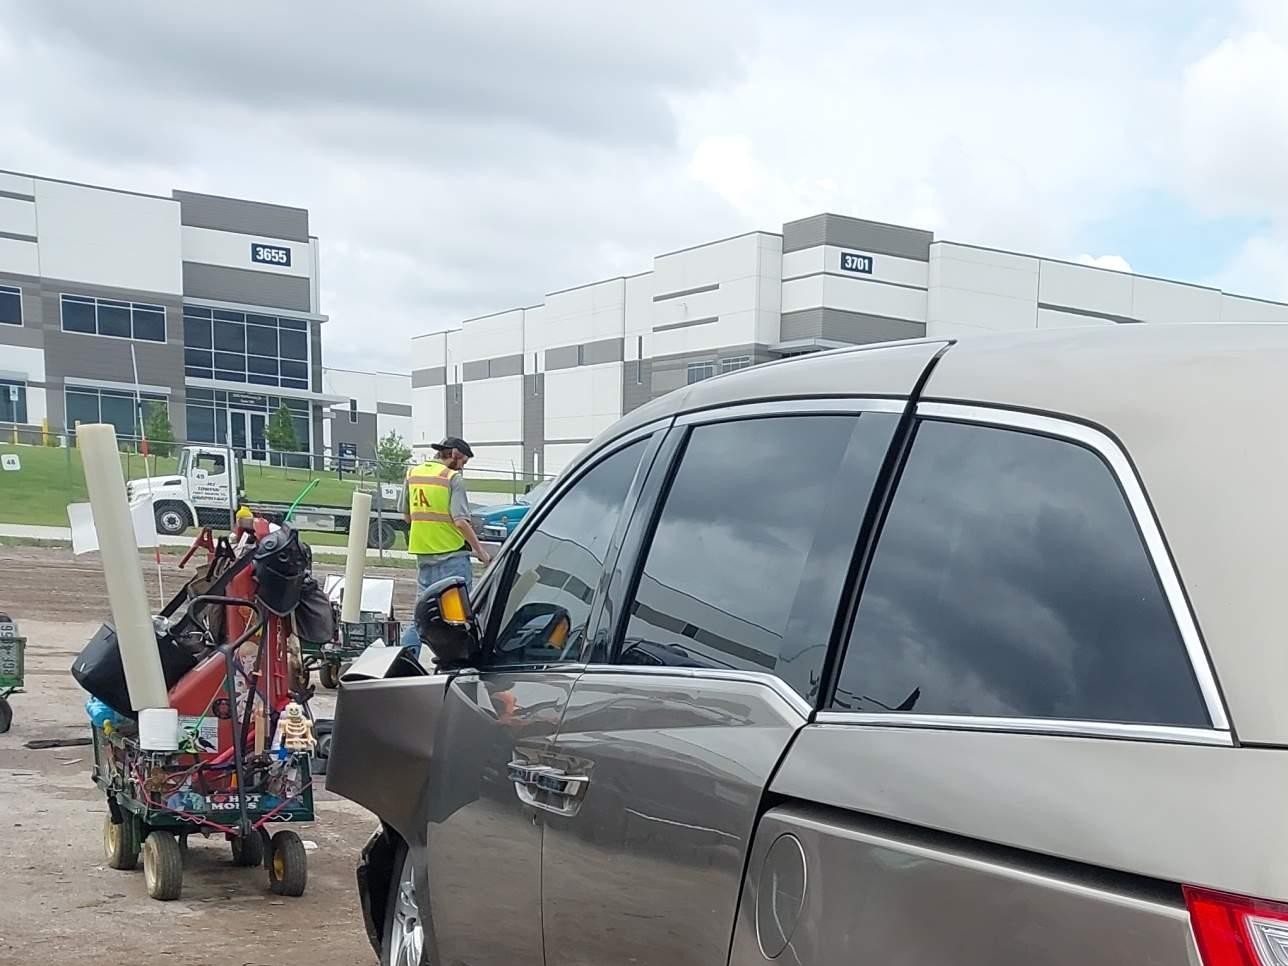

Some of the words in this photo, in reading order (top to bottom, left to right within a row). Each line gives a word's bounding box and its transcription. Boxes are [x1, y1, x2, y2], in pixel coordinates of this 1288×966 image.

[256, 247, 287, 263] 3655
[845, 256, 869, 271] 3701
[211, 802, 257, 810] MOS
